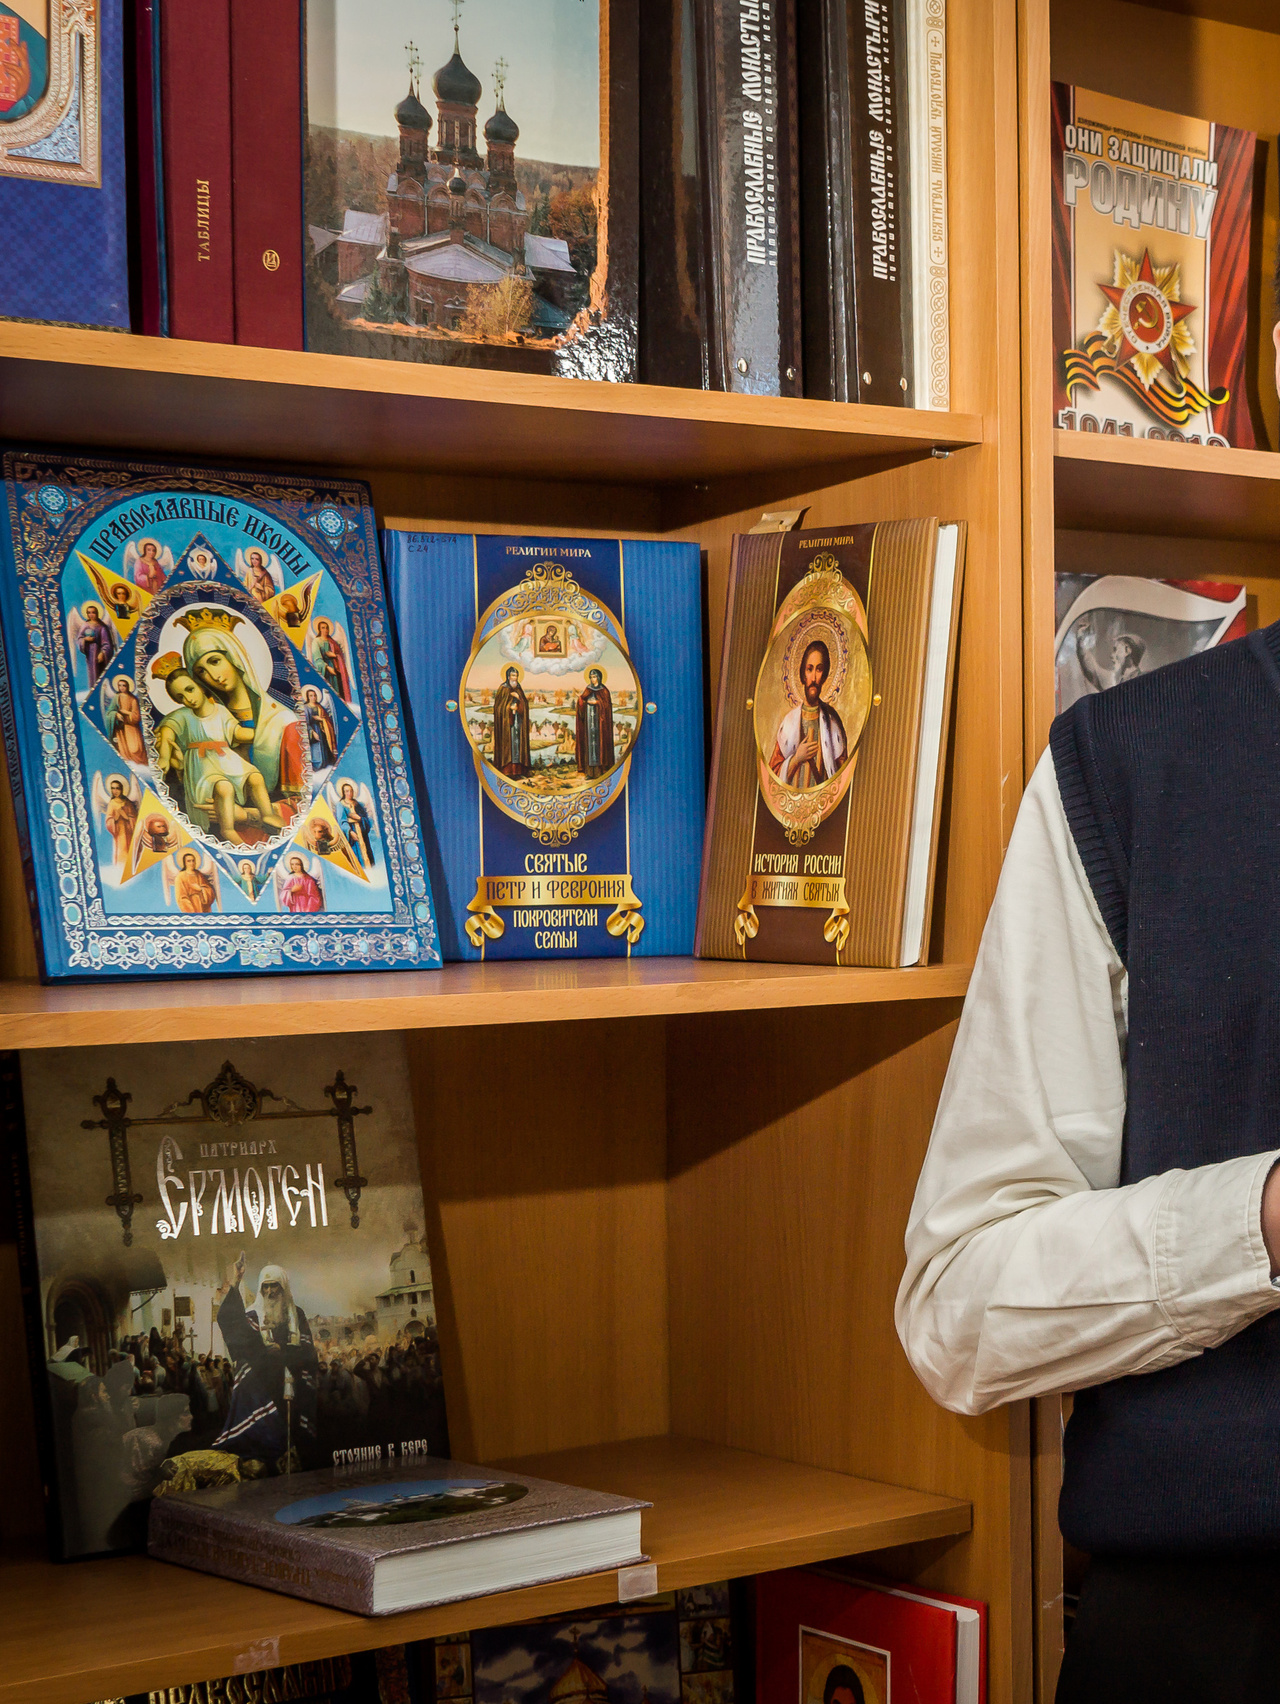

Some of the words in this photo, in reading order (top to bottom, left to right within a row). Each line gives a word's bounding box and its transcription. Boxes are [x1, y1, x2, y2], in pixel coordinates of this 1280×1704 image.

[740, 0, 762, 101] МОНАСТЫ
[1065, 124, 1102, 156] ОНИ
[1108, 135, 1218, 186] ЗАЩИЩАЛИ
[743, 110, 767, 265] ПРАВОСЛАВНЫЕ
[1063, 151, 1218, 241] РОДИНУ
[868, 130, 888, 280] ПРАВОСЛАВНЫЕ
[197, 179, 211, 262] ТАБЛИЦЫ
[88, 497, 240, 563] ПРАВОСЛАВНЫЕ
[242, 513, 311, 578] ИКОНЫ
[506, 546, 557, 557] РЕЛИГИИ
[560, 548, 592, 558] МИРА
[524, 853, 588, 873] СВЯТЫЕ
[754, 853, 799, 873] ИСТОРИЯ
[803, 854, 842, 874] РОССИИ
[486, 881, 526, 900] ПЕТР
[532, 881, 541, 899] И
[546, 880, 625, 899] ФЕВРОНИЯ
[751, 881, 758, 899] В
[762, 881, 799, 900] ЖИТИЯХ
[803, 882, 840, 902] СВЯТЫХ
[513, 908, 598, 928] ПОКРОВИТЕЛИ
[534, 930, 577, 949] СЕМЬИ
[200, 1139, 277, 1158] ПАТРИАРХ
[156, 1135, 328, 1240] ЕРМОГЕН
[333, 1444, 381, 1466] СТОЯНИЕ
[388, 1443, 395, 1458] В
[401, 1439, 428, 1456] ВЕРЕ
